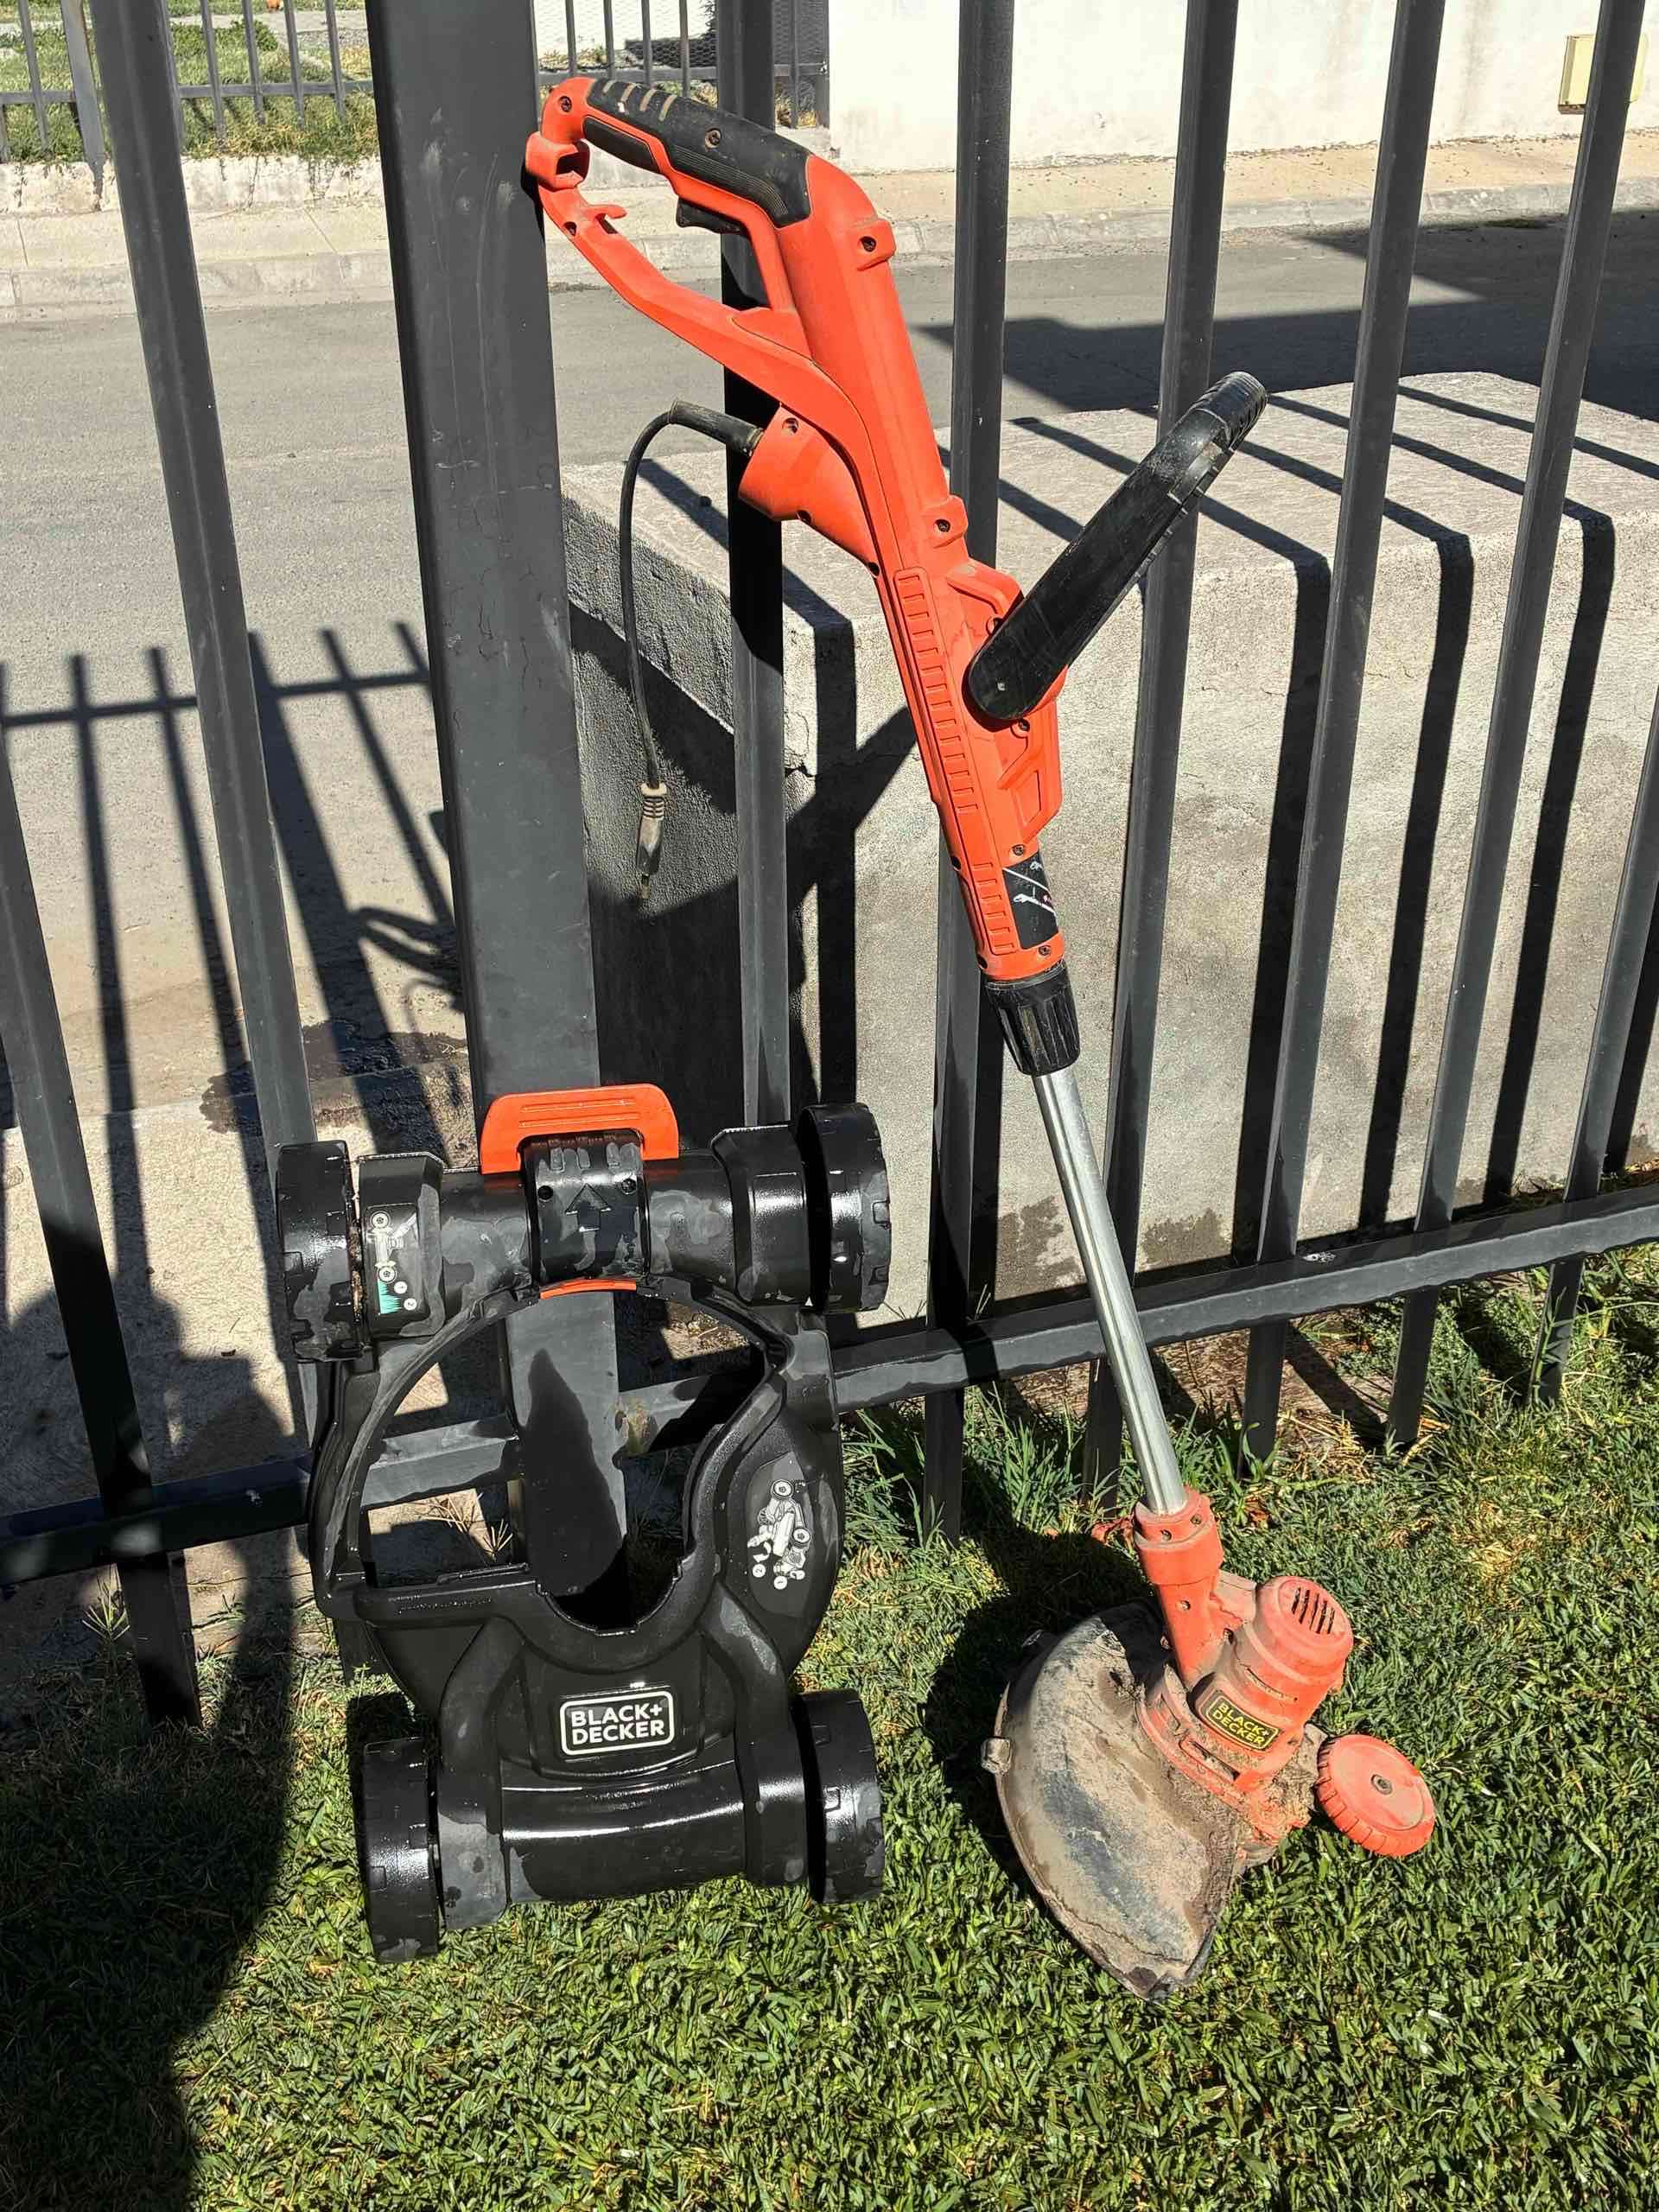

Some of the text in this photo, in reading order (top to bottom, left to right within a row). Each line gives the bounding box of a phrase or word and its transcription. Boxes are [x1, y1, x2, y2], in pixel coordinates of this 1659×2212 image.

[571, 1703, 663, 1727] BLACK+
[1212, 1709, 1265, 1745] DECKER
[1218, 1702, 1269, 1736] BLACK+
[572, 1719, 664, 1745] DECKER
